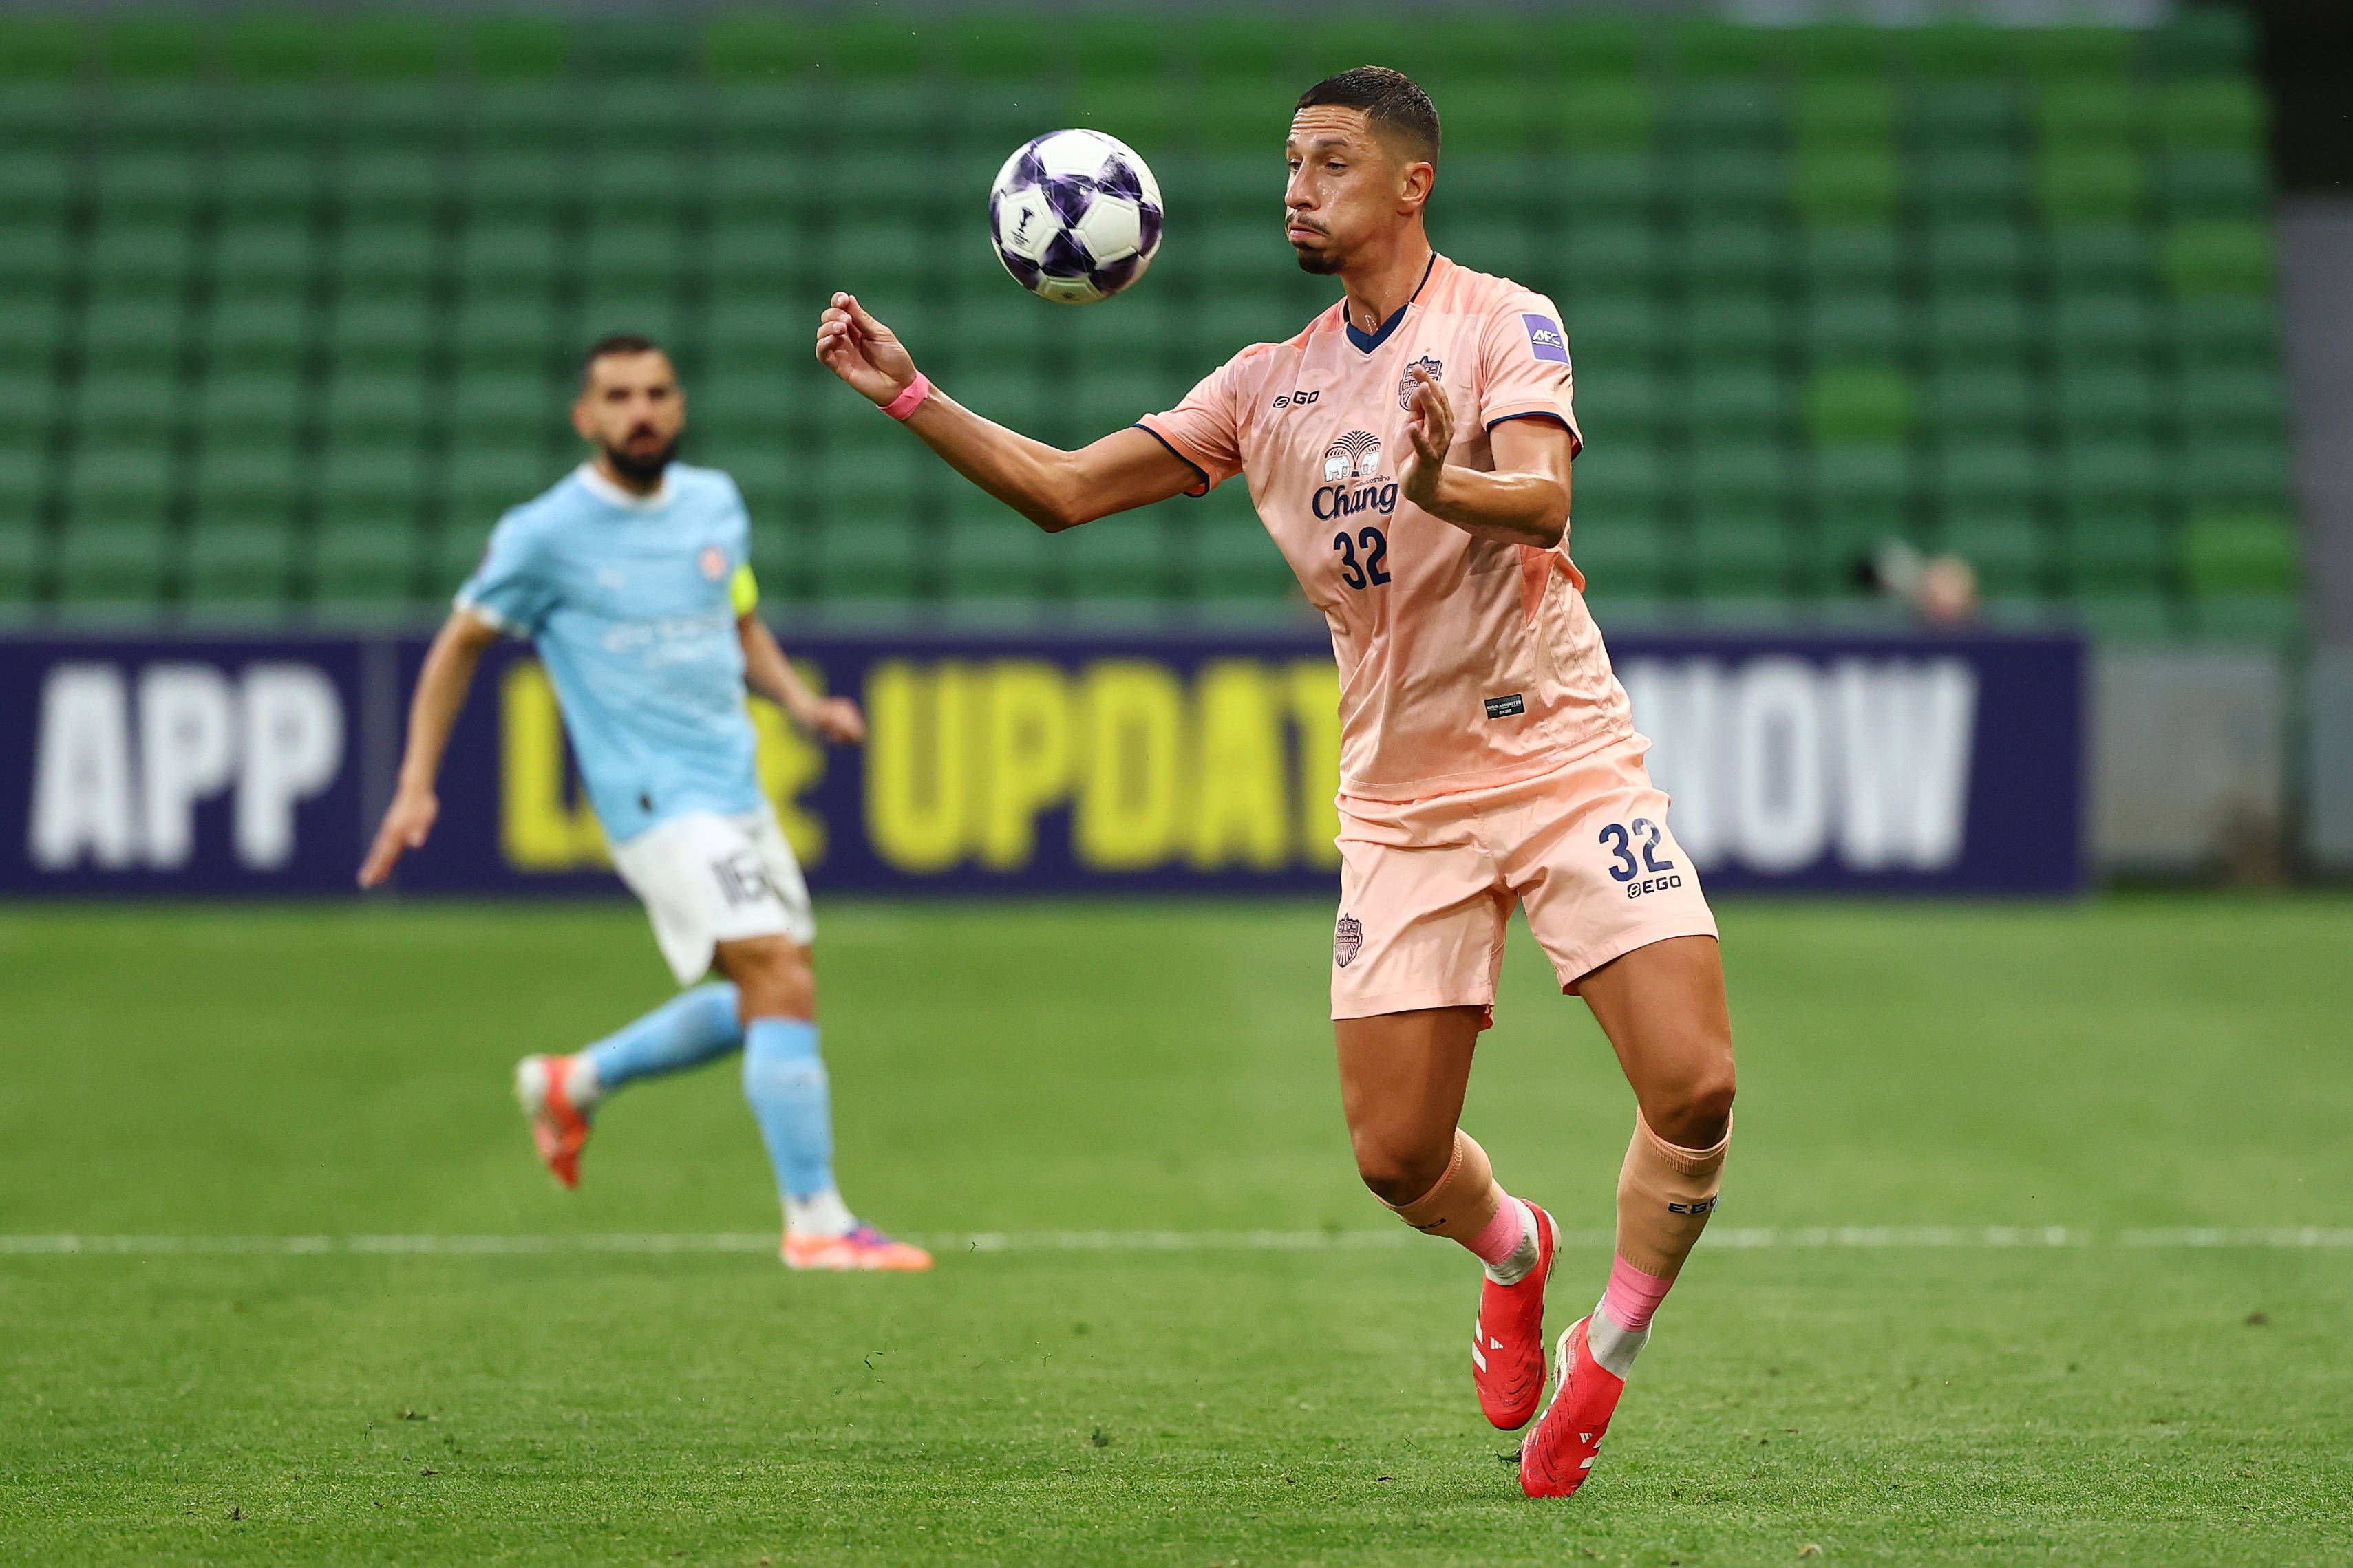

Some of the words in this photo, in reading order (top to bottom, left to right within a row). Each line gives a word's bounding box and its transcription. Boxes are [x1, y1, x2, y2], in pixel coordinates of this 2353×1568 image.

[1531, 329, 1561, 345] AFC
[1293, 390, 1320, 405] GO
[1312, 484, 1398, 521] Chang
[1334, 526, 1391, 590] 32
[31, 661, 344, 870] APP
[501, 658, 824, 872] LE
[866, 657, 1341, 872] UPDAT
[1623, 657, 1975, 870] NOW
[1599, 817, 1674, 882] 32
[1642, 875, 1681, 894] EGO
